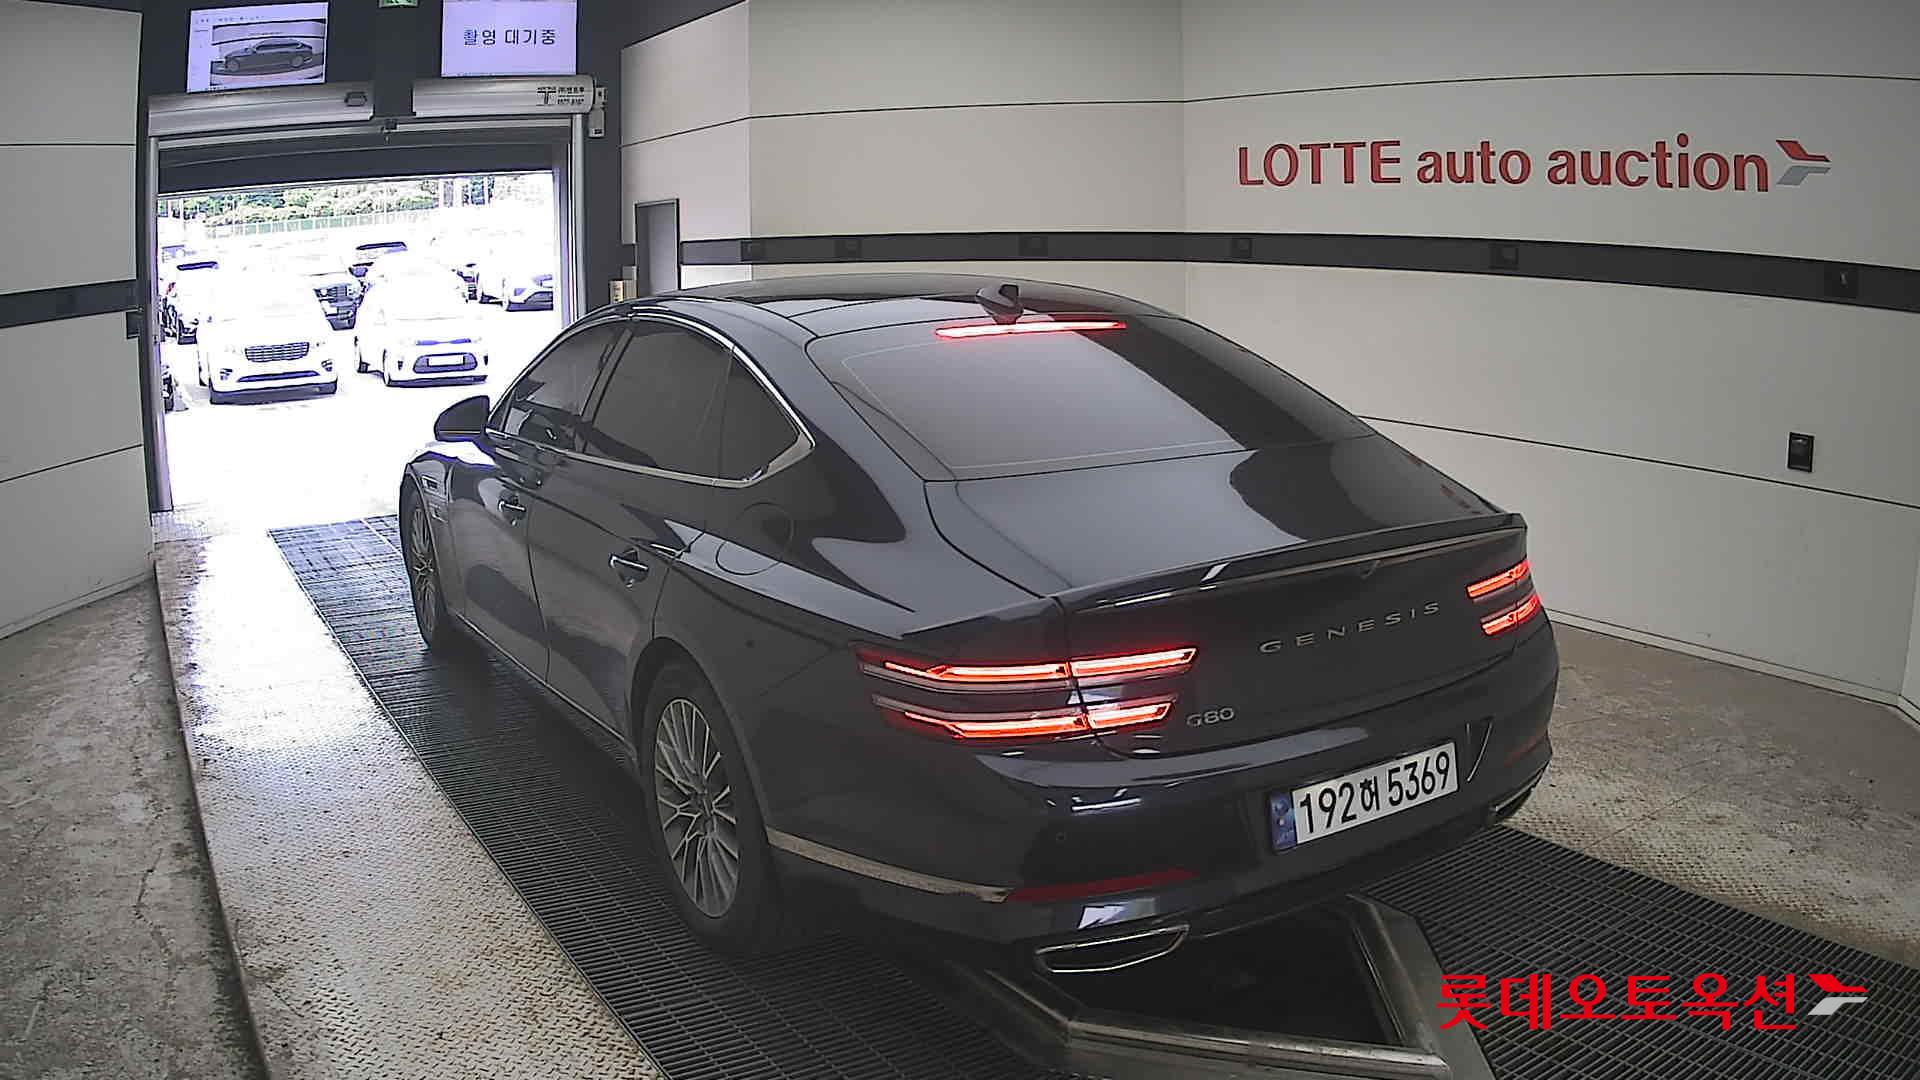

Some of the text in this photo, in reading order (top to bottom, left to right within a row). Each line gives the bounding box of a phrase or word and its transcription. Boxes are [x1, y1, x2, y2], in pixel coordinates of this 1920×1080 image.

[463, 29, 556, 45] 촬영 대기중
[1238, 134, 1769, 193] LOTTE auto auction
[1259, 601, 1440, 653] GENESIS
[1186, 707, 1235, 727] G80
[1387, 751, 1450, 806] 5369
